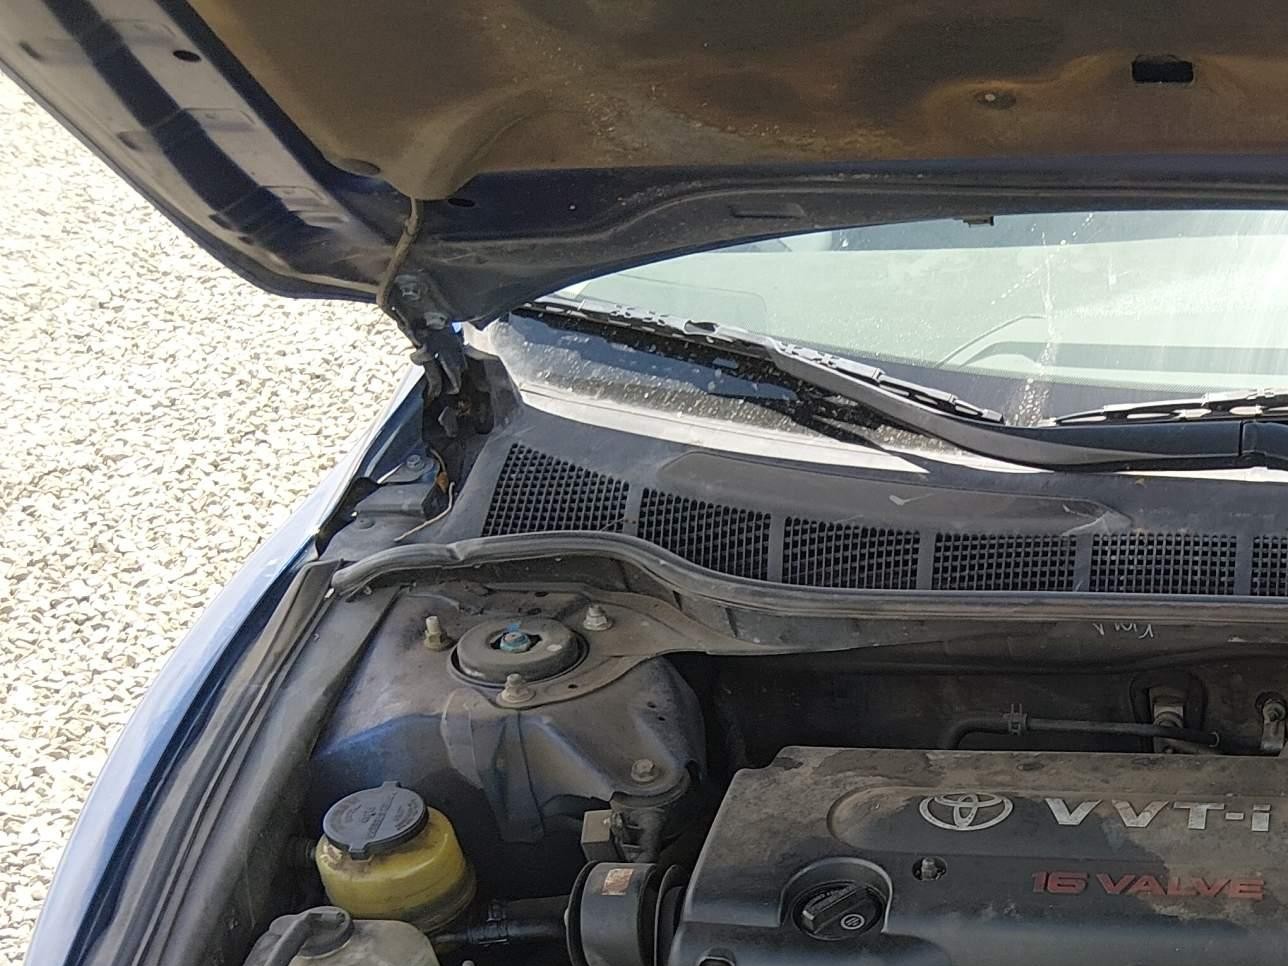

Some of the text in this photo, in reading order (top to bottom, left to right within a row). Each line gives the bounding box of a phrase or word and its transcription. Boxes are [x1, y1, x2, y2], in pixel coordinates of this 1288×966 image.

[1045, 798, 1271, 832] VVT-i
[1032, 871, 1265, 900] 16 VALVE
